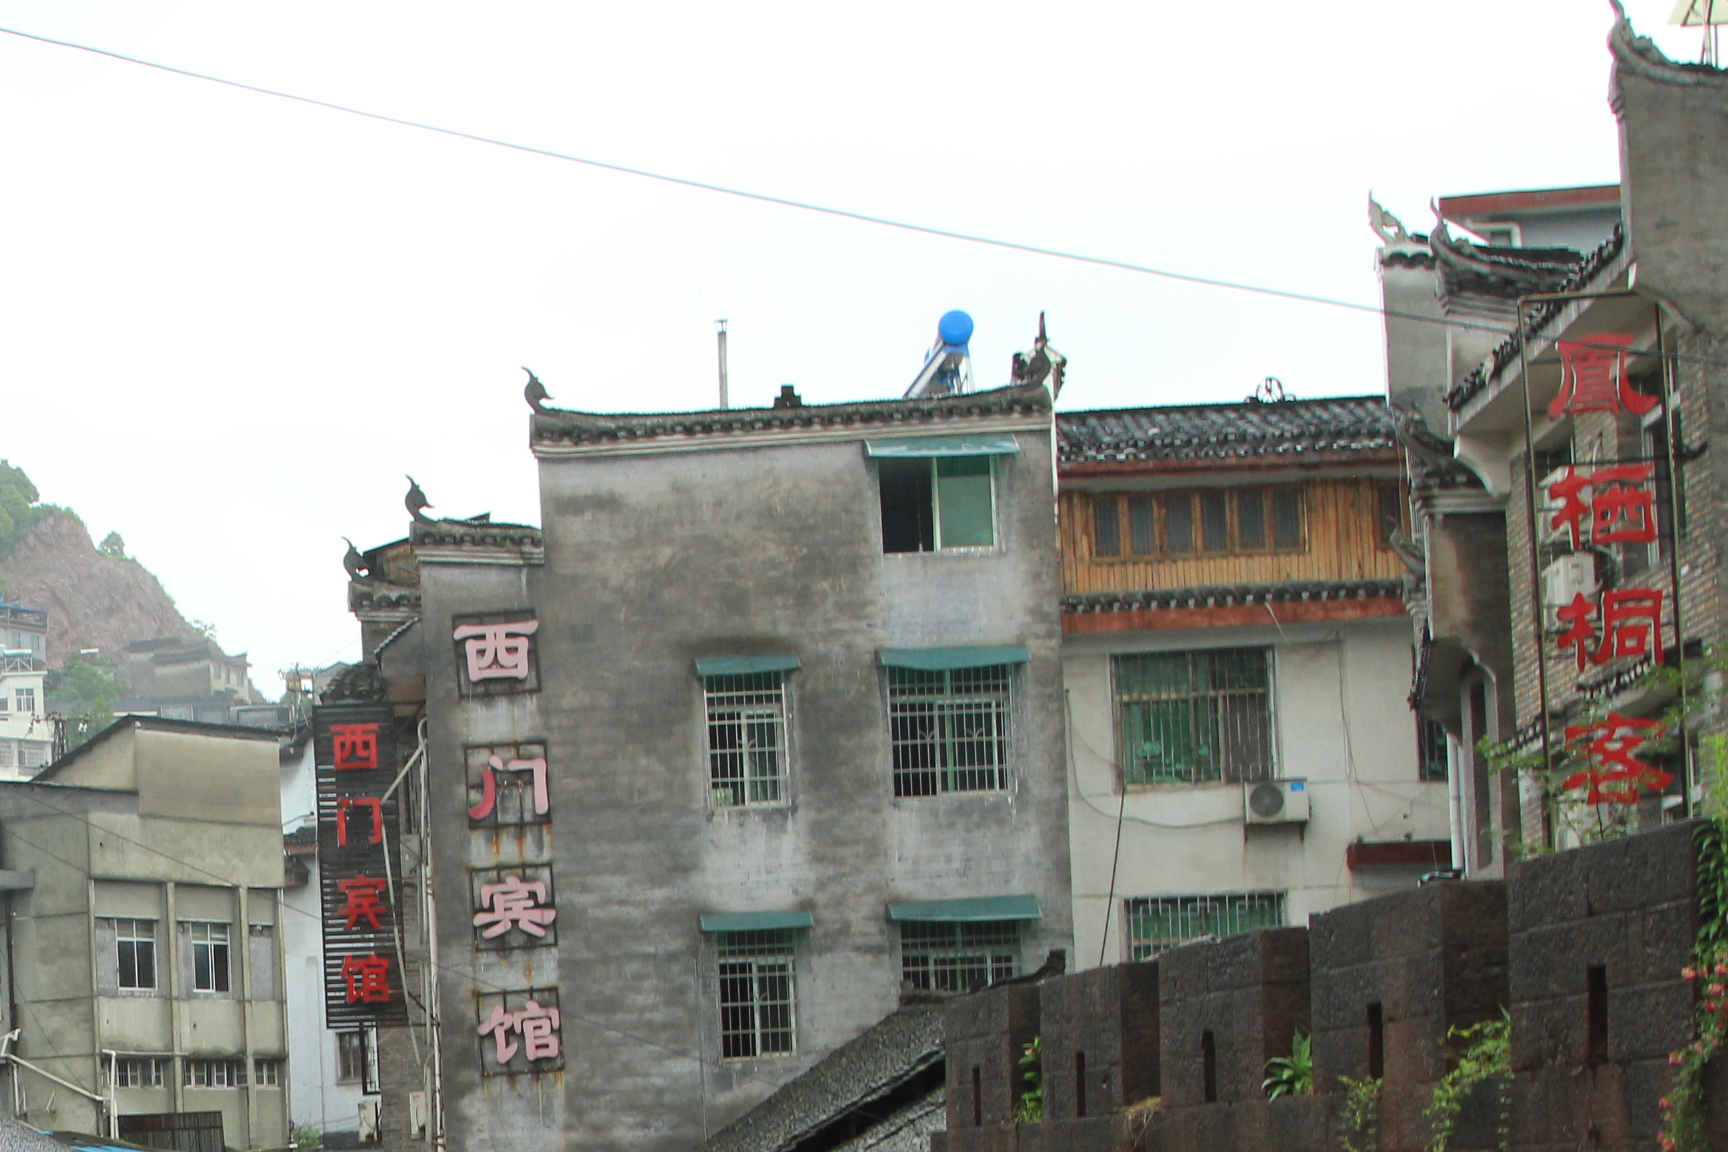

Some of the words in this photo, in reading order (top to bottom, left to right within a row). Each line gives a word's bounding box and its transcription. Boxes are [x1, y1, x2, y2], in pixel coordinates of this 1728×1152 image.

[330, 722, 390, 1005] 西门宾馆
[453, 619, 560, 1064] 西门宾馆
